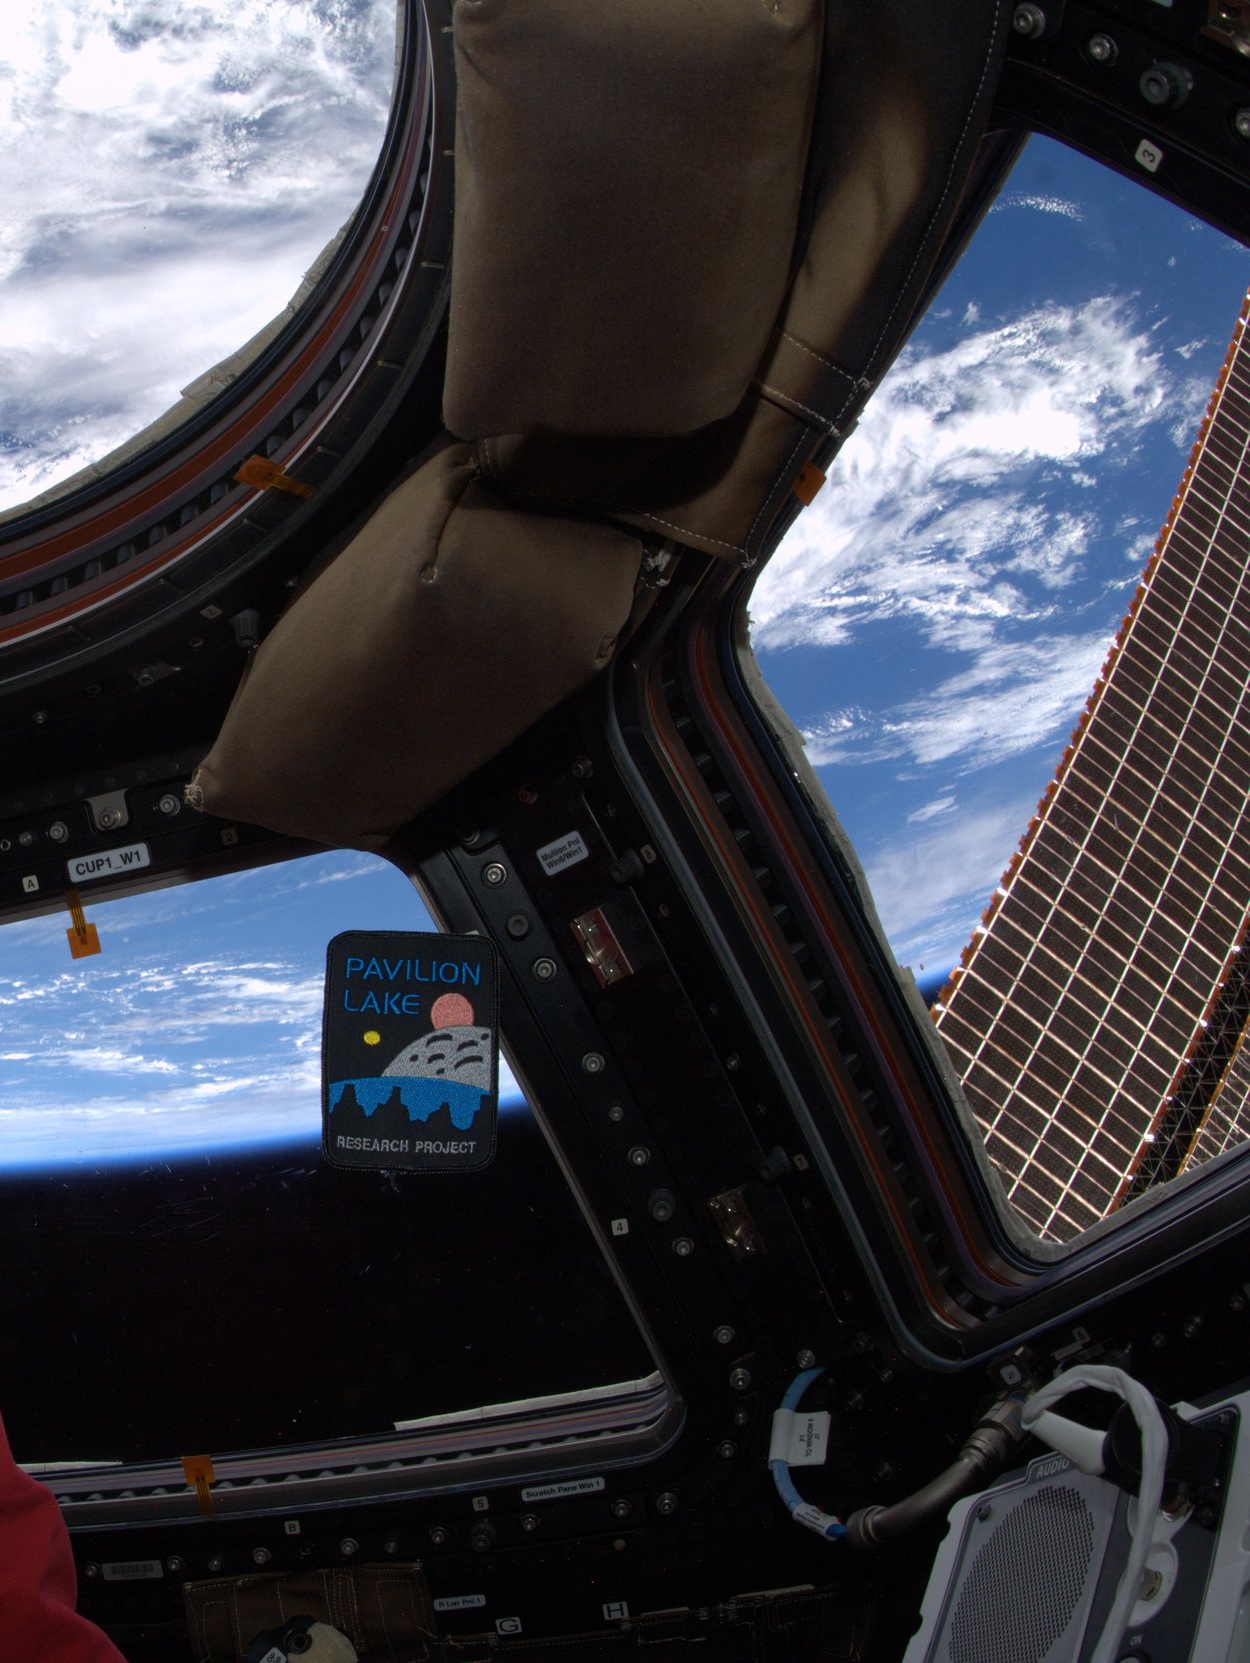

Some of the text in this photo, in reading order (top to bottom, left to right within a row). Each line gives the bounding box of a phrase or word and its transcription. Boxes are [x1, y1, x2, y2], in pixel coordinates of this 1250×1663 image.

[1142, 148, 1156, 163] 3
[225, 831, 234, 842] 2
[541, 836, 581, 862] Mullion Pnl
[75, 850, 141, 875] CUP1_W1
[546, 846, 583, 869] Win6/Win1
[27, 880, 35, 889] A
[345, 956, 483, 986] PAVILION
[343, 988, 421, 1016] LAKE
[336, 1135, 477, 1155] RESEARCH PROJECT
[617, 1222, 624, 1232] 4
[806, 1422, 814, 1447] WINDOW
[805, 1448, 813, 1457] TO
[1036, 1457, 1070, 1479] AUDIO
[526, 1488, 556, 1498] Scratch
[557, 1485, 578, 1493] Pane
[578, 1482, 594, 1490] Win
[477, 1499, 485, 1508] 5
[288, 1524, 296, 1532] B
[606, 1602, 624, 1618] H
[498, 1618, 519, 1632] G
[1130, 1634, 1143, 1646] ON
